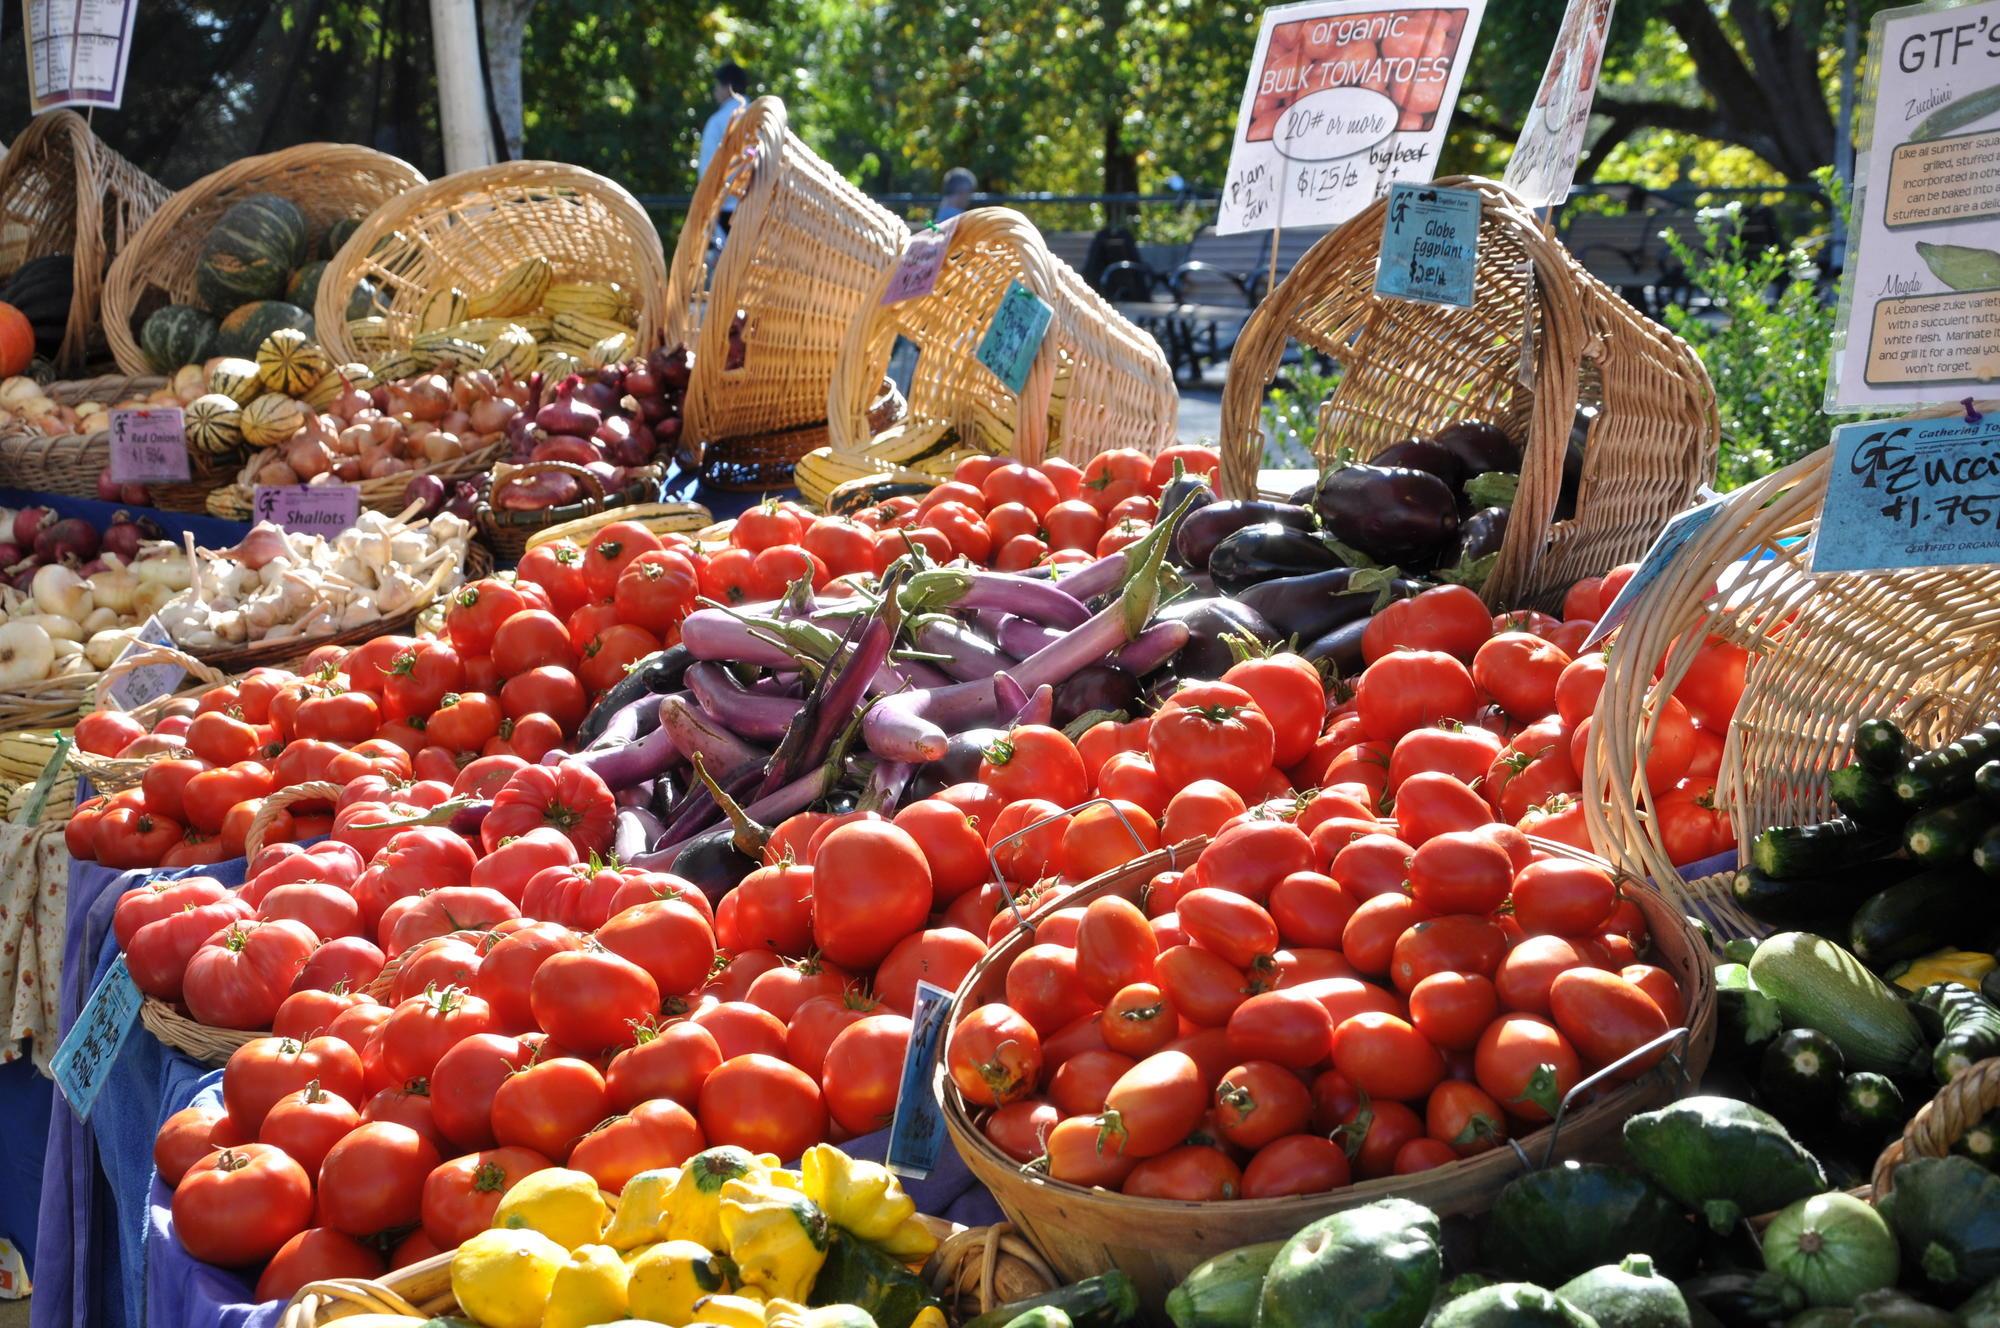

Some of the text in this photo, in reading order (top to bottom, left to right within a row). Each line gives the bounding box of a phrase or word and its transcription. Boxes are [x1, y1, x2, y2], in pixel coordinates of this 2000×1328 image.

[1312, 13, 1408, 47] organic
[1261, 57, 1450, 95] BULK TOMATOES
[1905, 82, 1953, 121] Zucchini
[1326, 118, 1347, 135] or
[1347, 114, 1387, 135] more
[1395, 142, 1430, 164] beef
[1899, 149, 1917, 159] Like
[1919, 147, 1930, 156] all
[1931, 142, 1973, 154] summer
[1956, 153, 1994, 167] stuffed
[1903, 172, 1968, 189] incorporated
[1969, 171, 1979, 180] in
[1907, 193, 1925, 203] can
[1927, 191, 1939, 201] be
[1941, 187, 1971, 199] baked
[1973, 184, 1993, 196] into
[1892, 208, 1930, 220] stuffed
[1932, 205, 1951, 215] and
[1953, 203, 1970, 213] are
[1971, 202, 1978, 210] a
[1425, 220, 1456, 239] Globe
[1413, 237, 1463, 259] Eggplant
[1878, 272, 1923, 303] Magda
[1885, 306, 1891, 315] A
[1893, 302, 1941, 315] Lebanese
[1943, 300, 1966, 311] zuke
[1888, 320, 1911, 330] with
[1912, 320, 1918, 328] a
[1920, 315, 1969, 328] succulent
[1884, 335, 1912, 345] white
[1946, 328, 1992, 341] Marinate
[1878, 351, 1898, 361] and
[1899, 349, 1918, 361] grill
[1919, 349, 1927, 358] it
[1929, 347, 1945, 358] for
[1947, 348, 1953, 356] a
[1955, 345, 1981, 356] meal
[1905, 361, 1972, 374] won't forget.
[131, 432, 180, 444] Red Onions
[1918, 425, 1980, 439] Gathering
[286, 510, 345, 525] Shallots
[1905, 543, 1955, 554] CERTIFIED
